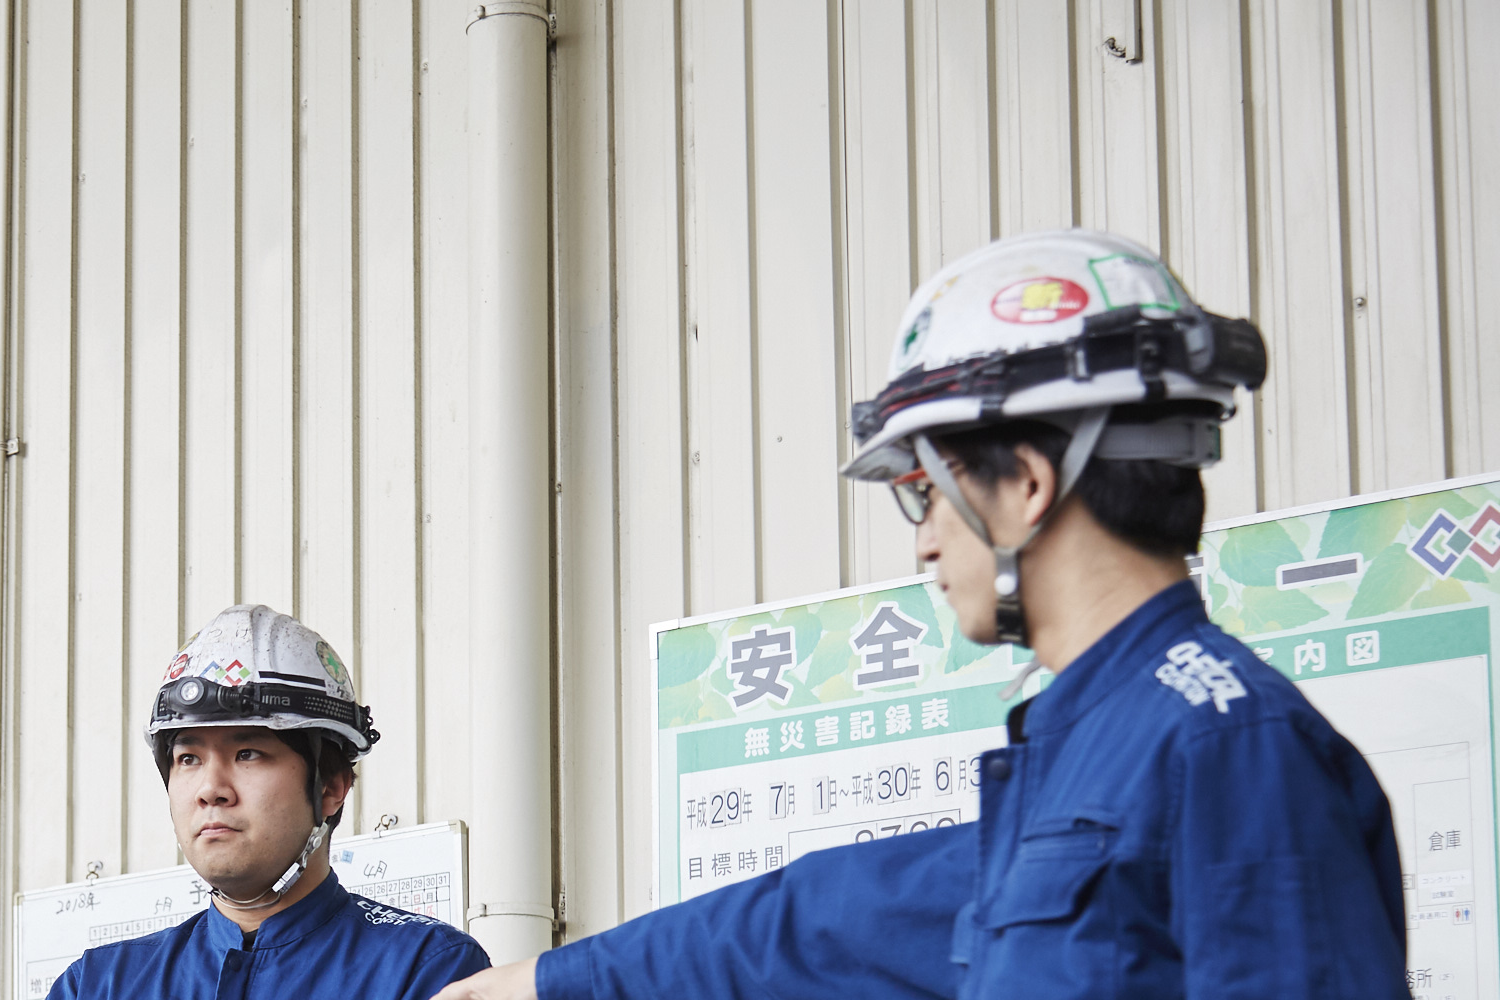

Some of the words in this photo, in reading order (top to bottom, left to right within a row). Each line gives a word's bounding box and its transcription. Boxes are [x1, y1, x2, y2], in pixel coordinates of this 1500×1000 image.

[744, 698, 949, 759] 無災害記録表
[686, 789, 753, 830] 平成29年
[1428, 829, 1462, 851] 倉庫
[688, 845, 784, 880] 目標時間
[364, 887, 374, 896] 25
[376, 885, 386, 893] 26
[388, 883, 398, 892] 27
[401, 881, 411, 890] 28
[413, 879, 423, 888] 29
[426, 877, 435, 886] 30
[438, 875, 447, 884] 31
